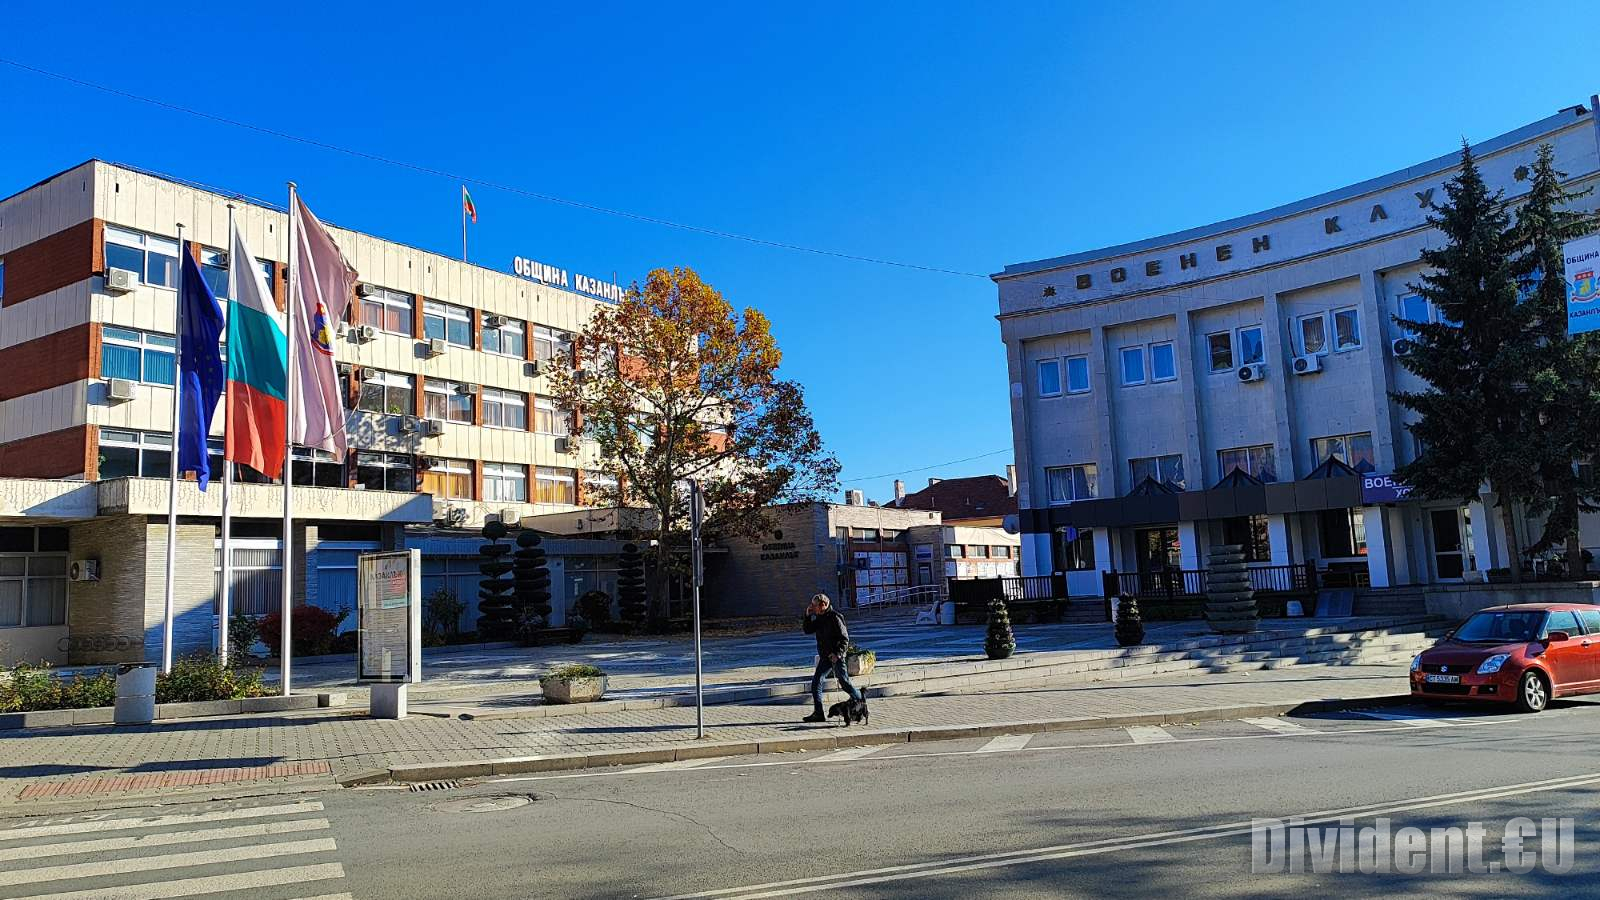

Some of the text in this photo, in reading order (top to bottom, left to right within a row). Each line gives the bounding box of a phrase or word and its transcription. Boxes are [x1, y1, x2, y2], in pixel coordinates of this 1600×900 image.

[1076, 187, 1435, 290] ВОЕНЕН КЛУ
[1566, 250, 1600, 265] ОБЩИНА
[514, 256, 628, 303] ОБЩИНА КАЗАНЛЪ
[1569, 307, 1600, 319] КАЗАНЛЪ
